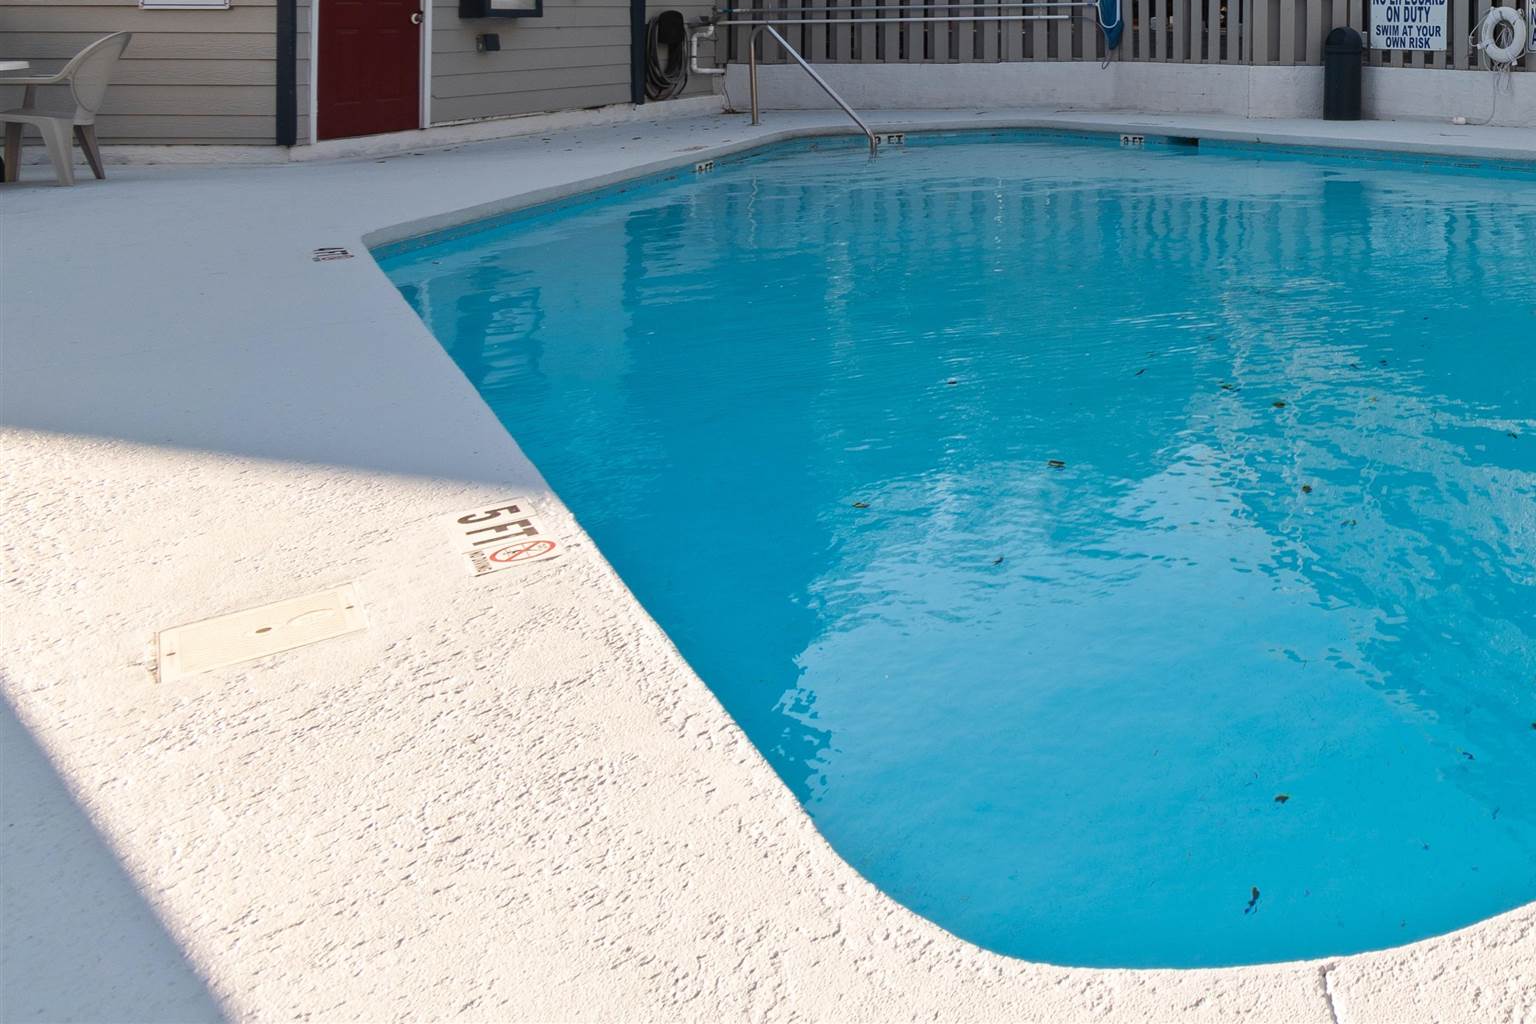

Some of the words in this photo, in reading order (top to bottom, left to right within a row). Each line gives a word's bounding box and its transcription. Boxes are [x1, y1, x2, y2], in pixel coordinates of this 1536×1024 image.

[1386, 6, 1400, 22] ON
[1404, 6, 1430, 23] DUTY
[1376, 24, 1399, 36] SWIM
[1402, 25, 1413, 36] AT
[1416, 25, 1441, 37] YOUR
[1385, 37, 1406, 48] OWN
[1409, 37, 1431, 49] RISK
[457, 504, 520, 524] 5
[465, 519, 539, 546] FT
